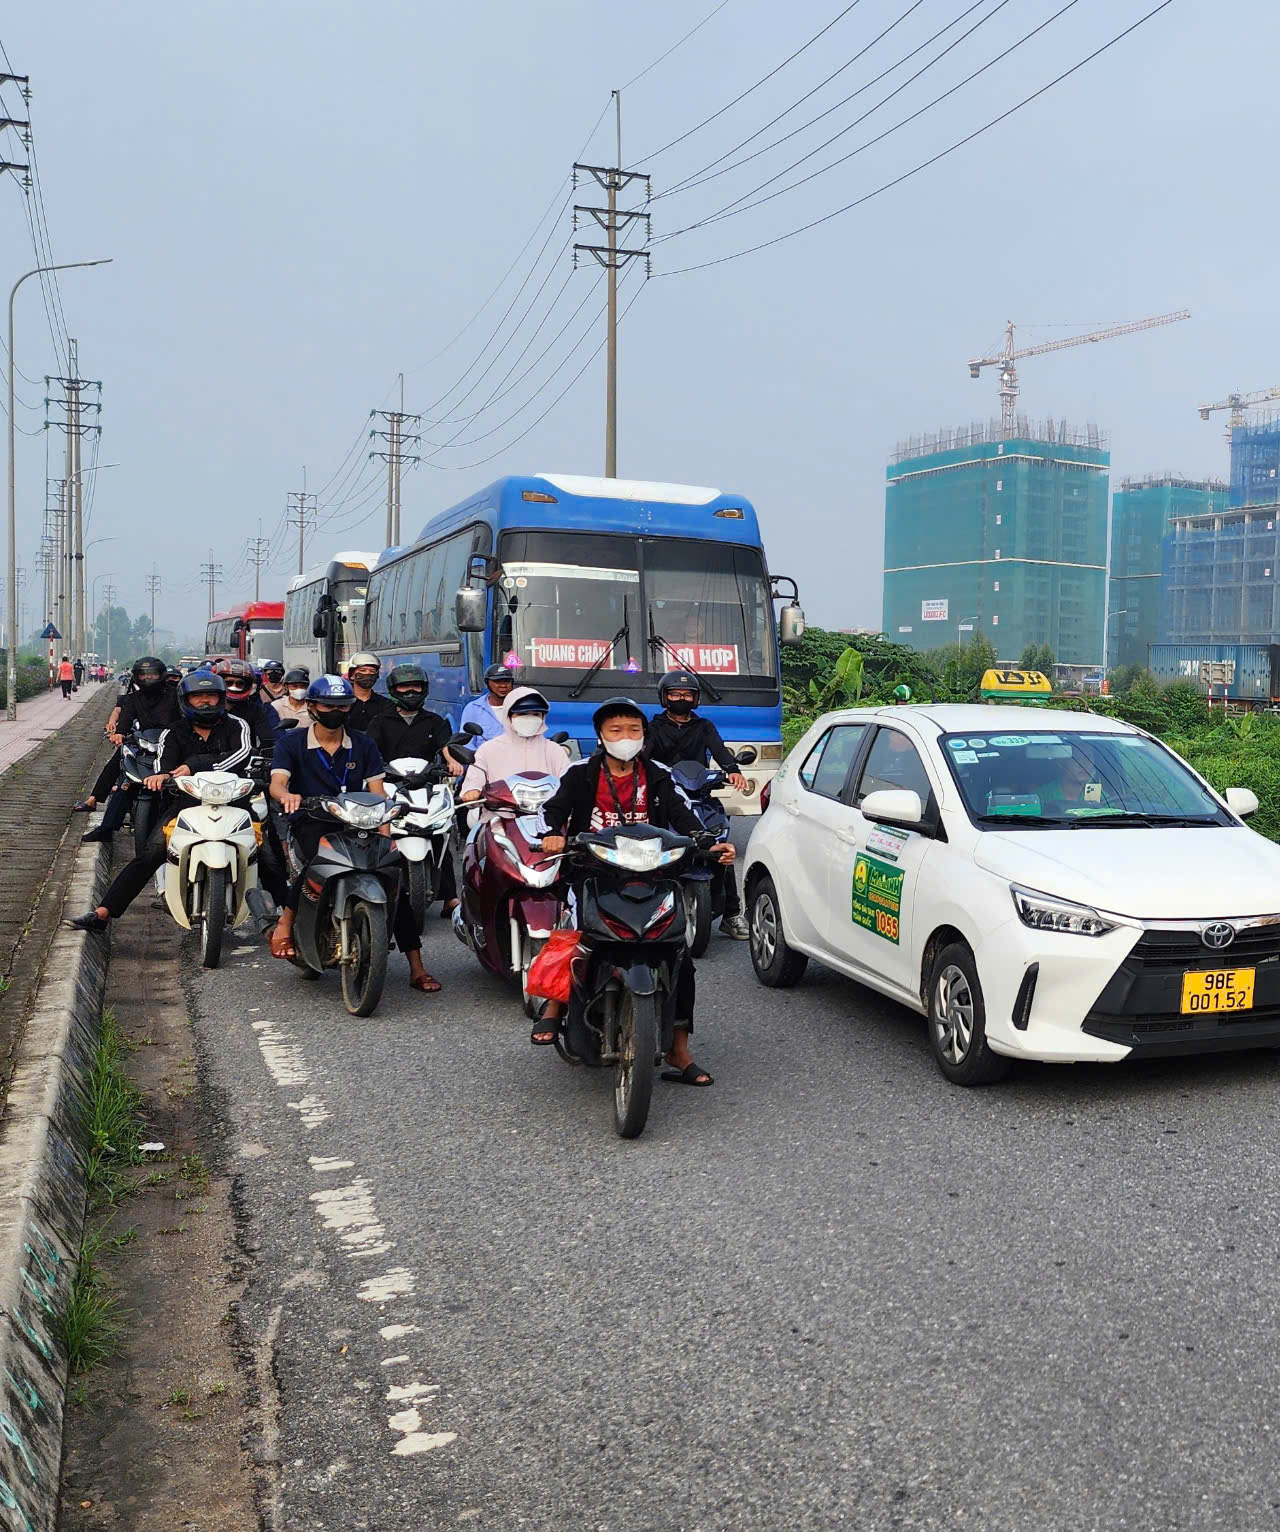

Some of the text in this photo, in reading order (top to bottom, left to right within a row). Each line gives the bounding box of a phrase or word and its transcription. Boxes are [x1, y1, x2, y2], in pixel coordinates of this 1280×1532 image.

[539, 644, 576, 663] QUANG
[699, 647, 734, 671] HỢP
[876, 909, 899, 940] 1055
[1204, 973, 1236, 991] 98E
[1190, 991, 1247, 1011] 001.52
